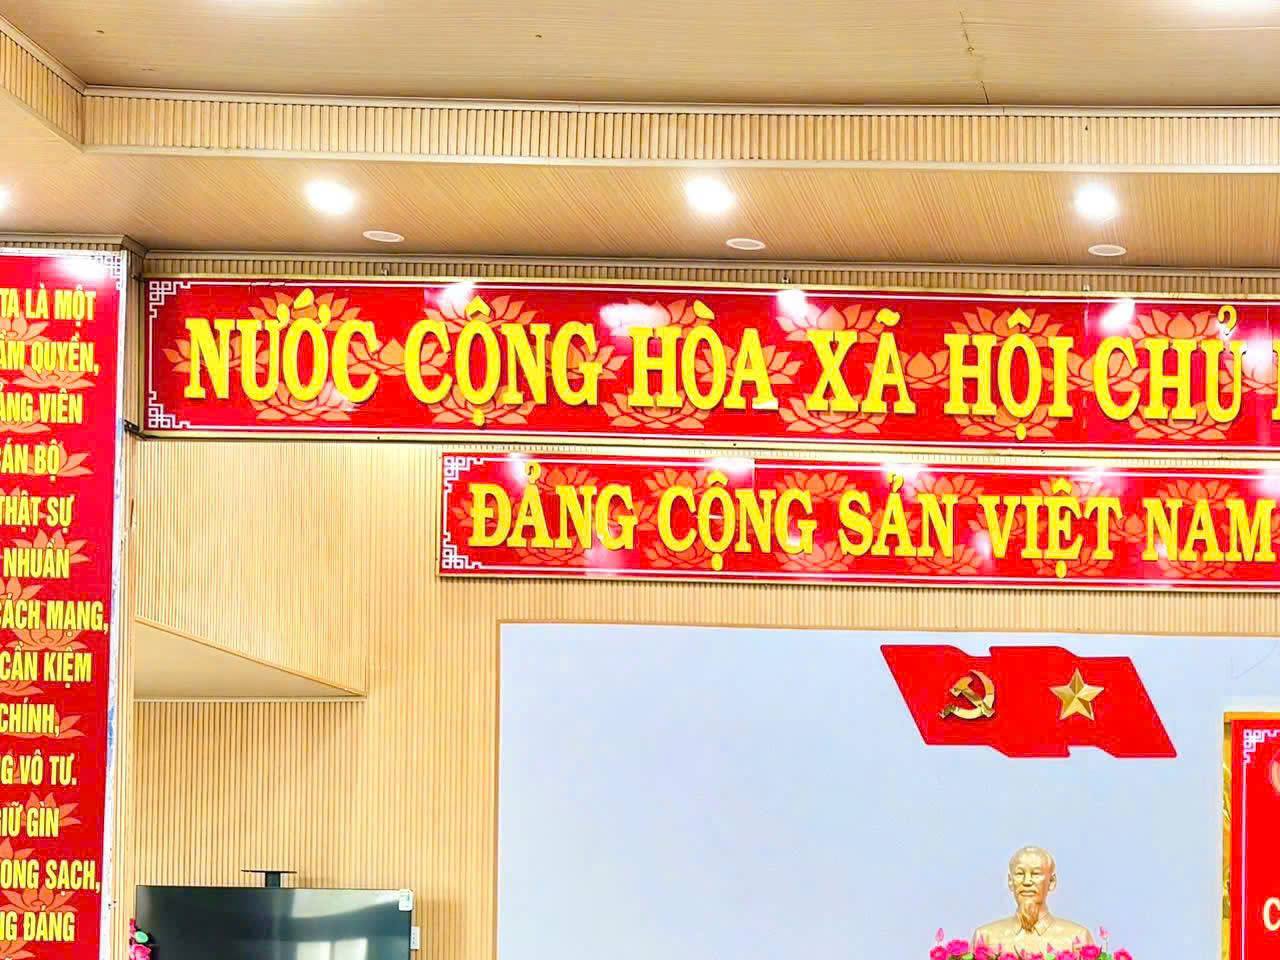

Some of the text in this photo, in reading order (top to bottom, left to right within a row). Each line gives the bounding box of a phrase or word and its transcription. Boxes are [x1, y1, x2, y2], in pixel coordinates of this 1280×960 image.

[25, 282, 49, 319] LÀ
[55, 284, 97, 327] MỘT
[0, 331, 99, 376] ẦM QUYỀN,
[183, 288, 379, 401] NƯỚC
[404, 297, 602, 426] CỘNG
[627, 300, 779, 411] HÒA
[806, 308, 915, 414] XÃ
[943, 308, 1075, 440] HỘI
[1093, 305, 1247, 422] CHỦ
[0, 382, 83, 424] ẢNG VIÊN
[0, 437, 60, 481] ÁN BỘ
[47, 494, 75, 534] SỰ
[468, 461, 637, 550] ĐẢNG
[657, 469, 817, 571] CỘNG
[838, 474, 957, 557] SẢN
[978, 476, 1123, 578] VIỆT
[1142, 498, 1277, 562] NAM
[3, 538, 70, 578] NHUẦN
[0, 592, 108, 640] ÁCH MẠNG,
[0, 641, 92, 688] CẦN KIỆM
[20, 748, 44, 785] VÔ
[49, 753, 77, 785] TƯ.
[0, 801, 59, 837] IỮ GÌN
[0, 859, 100, 896] ONG SẠCH,
[23, 905, 75, 941] ĐÁNG
